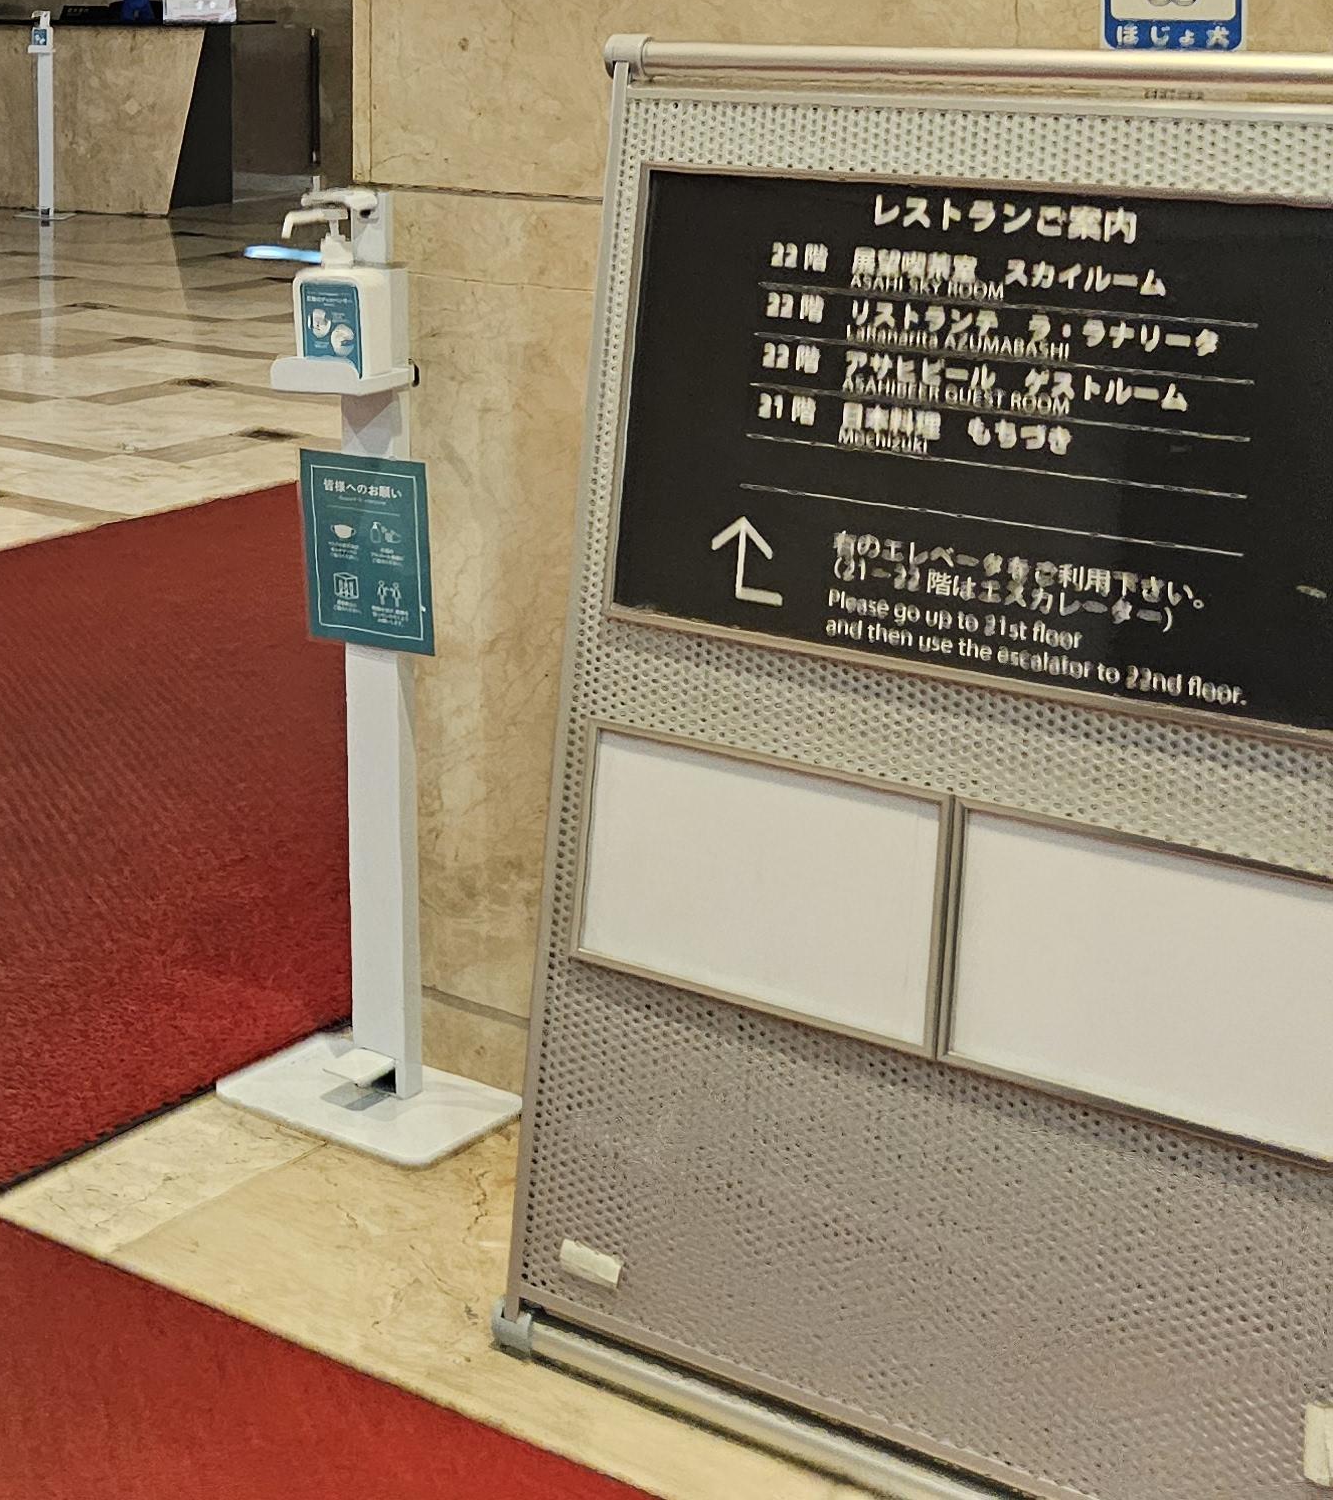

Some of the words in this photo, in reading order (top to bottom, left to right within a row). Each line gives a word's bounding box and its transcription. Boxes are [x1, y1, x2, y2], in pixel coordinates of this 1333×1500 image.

[1116, 24, 1230, 47] ほじょ犬
[874, 194, 1137, 244] レストランご案内
[850, 276, 903, 293] ASAHI
[908, 279, 943, 297] SKY
[947, 281, 1004, 300] ROOM
[1005, 259, 1167, 297] スカイルーム
[944, 334, 1070, 360] AZUMABASHI
[846, 350, 996, 390] アサヒビール
[1025, 367, 1188, 412] ゲストルーム
[1011, 390, 1070, 415] ROOM
[323, 478, 402, 499] 皆様へのお願い
[828, 588, 890, 619] Please
[893, 602, 921, 627] go
[925, 609, 953, 631] up
[957, 610, 978, 632] to
[1032, 620, 1082, 650] floor
[826, 619, 863, 640] and
[867, 623, 913, 647] then
[918, 634, 953, 654] use
[958, 637, 992, 661] the
[997, 645, 1094, 680] escalator
[1097, 662, 1120, 684] to
[1125, 665, 1182, 697] 22nd
[1188, 675, 1247, 706] floor.
